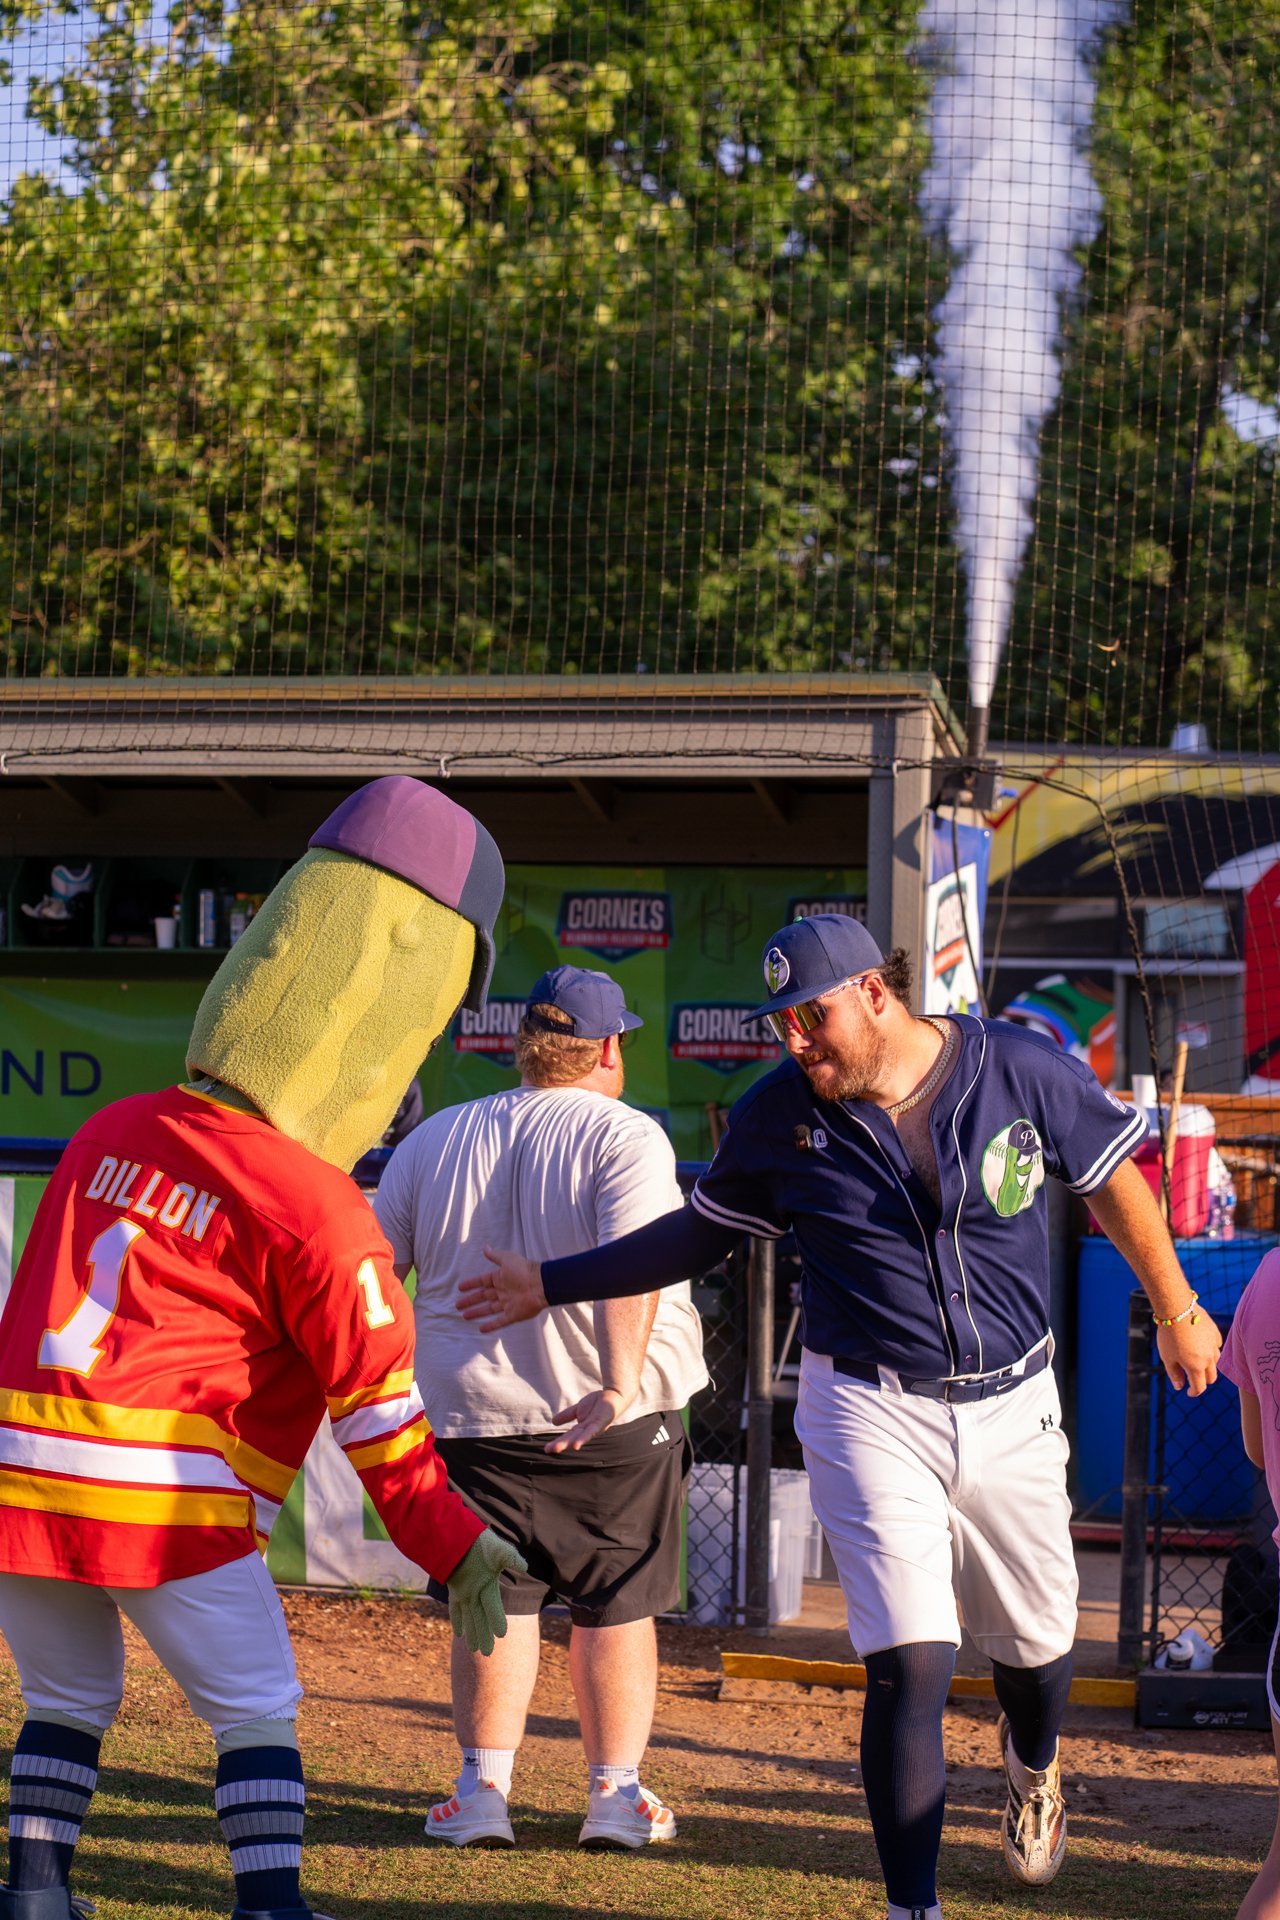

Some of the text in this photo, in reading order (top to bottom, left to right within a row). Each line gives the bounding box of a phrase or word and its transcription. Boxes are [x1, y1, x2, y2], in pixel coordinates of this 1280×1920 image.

[567, 898, 665, 931] CORNEL'S
[461, 1003, 527, 1035] CORN
[1, 1050, 102, 1097] ND
[1020, 1129, 1034, 1147] P
[84, 1155, 222, 1242] DILLON
[37, 1216, 145, 1379] 1
[357, 1258, 395, 1330] 1
